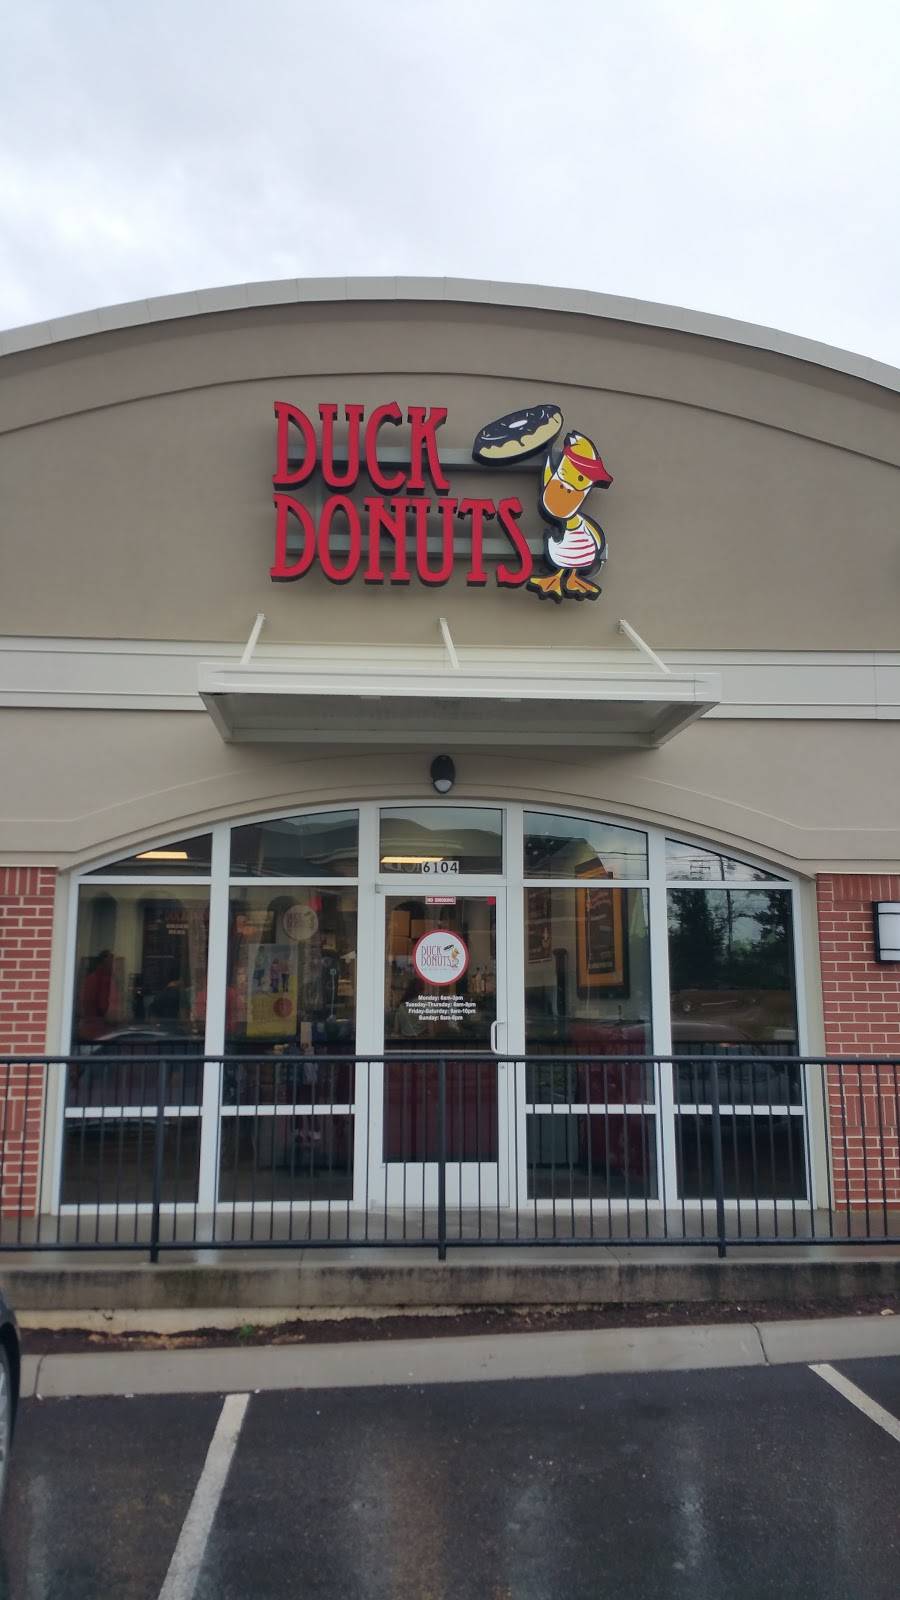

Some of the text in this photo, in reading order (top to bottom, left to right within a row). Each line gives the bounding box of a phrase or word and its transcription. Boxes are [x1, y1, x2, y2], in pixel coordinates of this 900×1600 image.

[272, 400, 450, 495] DUCK
[270, 493, 533, 587] DONUTS
[423, 861, 458, 873] 6104
[421, 945, 442, 957] DUCK
[421, 956, 451, 967] DONUTS
